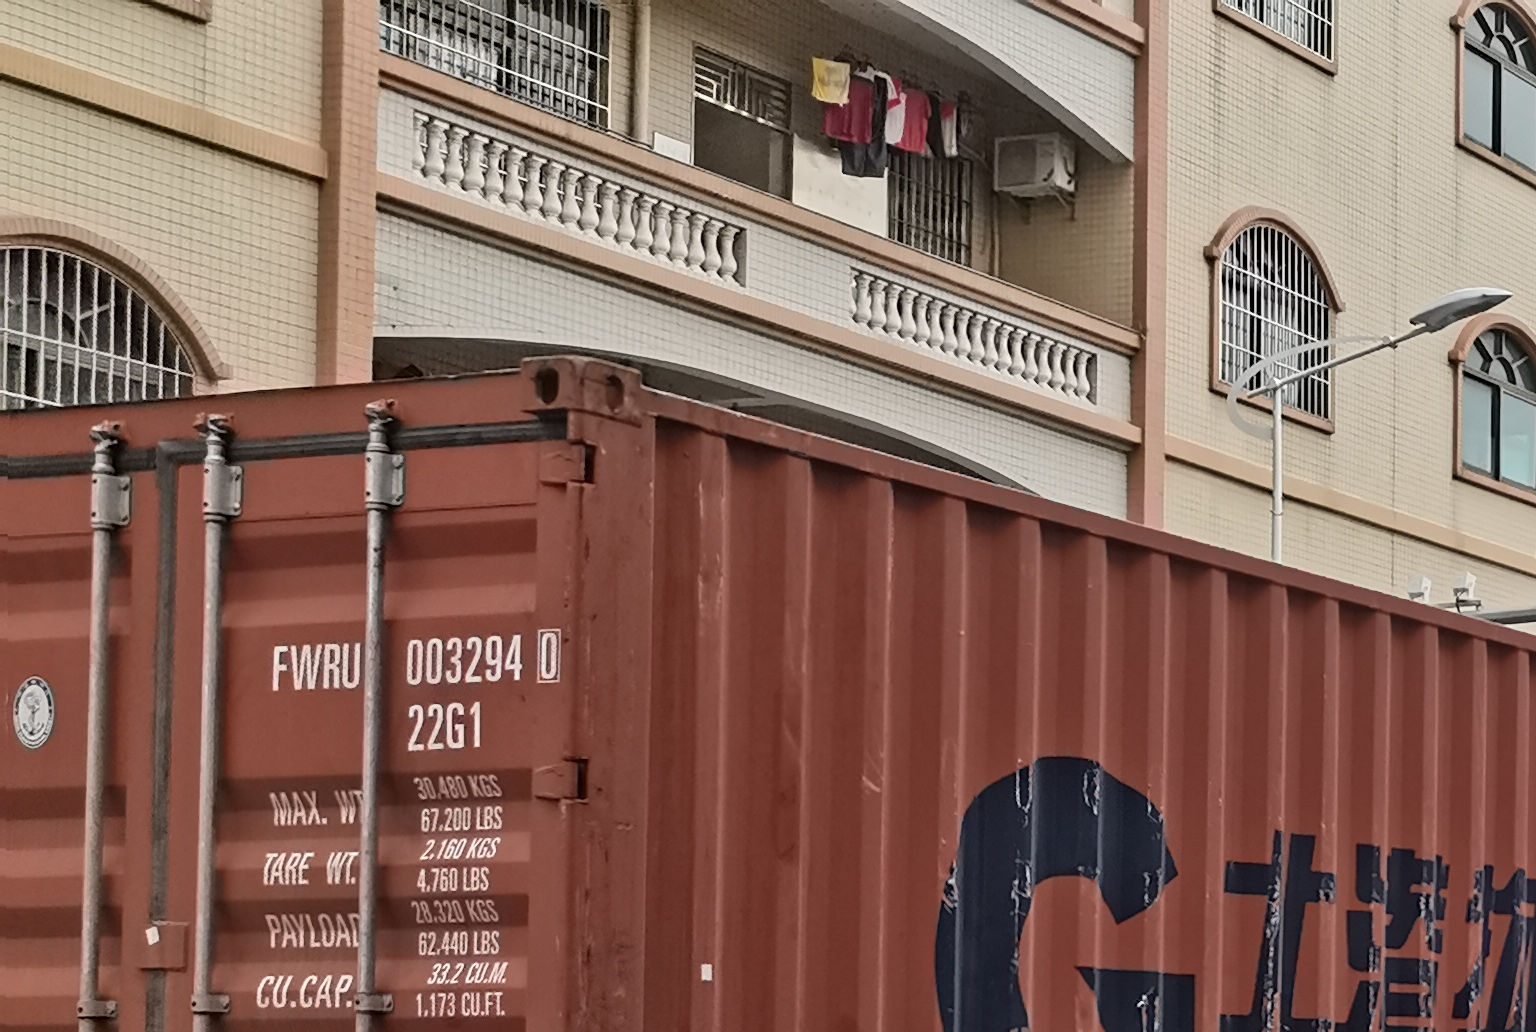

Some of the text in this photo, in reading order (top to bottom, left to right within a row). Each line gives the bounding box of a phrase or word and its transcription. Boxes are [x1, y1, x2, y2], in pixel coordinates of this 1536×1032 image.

[271, 628, 561, 691] FWRU 003294 0
[407, 701, 481, 751] 22G1
[413, 774, 503, 801] 30.480 KGS
[269, 791, 328, 826] MAX.
[421, 806, 503, 832] 67.200 LBS
[465, 837, 501, 859] KGS
[263, 851, 360, 885] TARE WT.
[416, 866, 490, 892] 4.760 LBS
[411, 899, 499, 924] 28.320 KGS
[264, 912, 360, 949] PAYLOAD
[418, 930, 500, 956] 62.440 LBS
[426, 961, 509, 985] 33.2 CU.M.
[255, 974, 354, 1009] CU.CAP.
[460, 991, 506, 1017] CU.FT.
